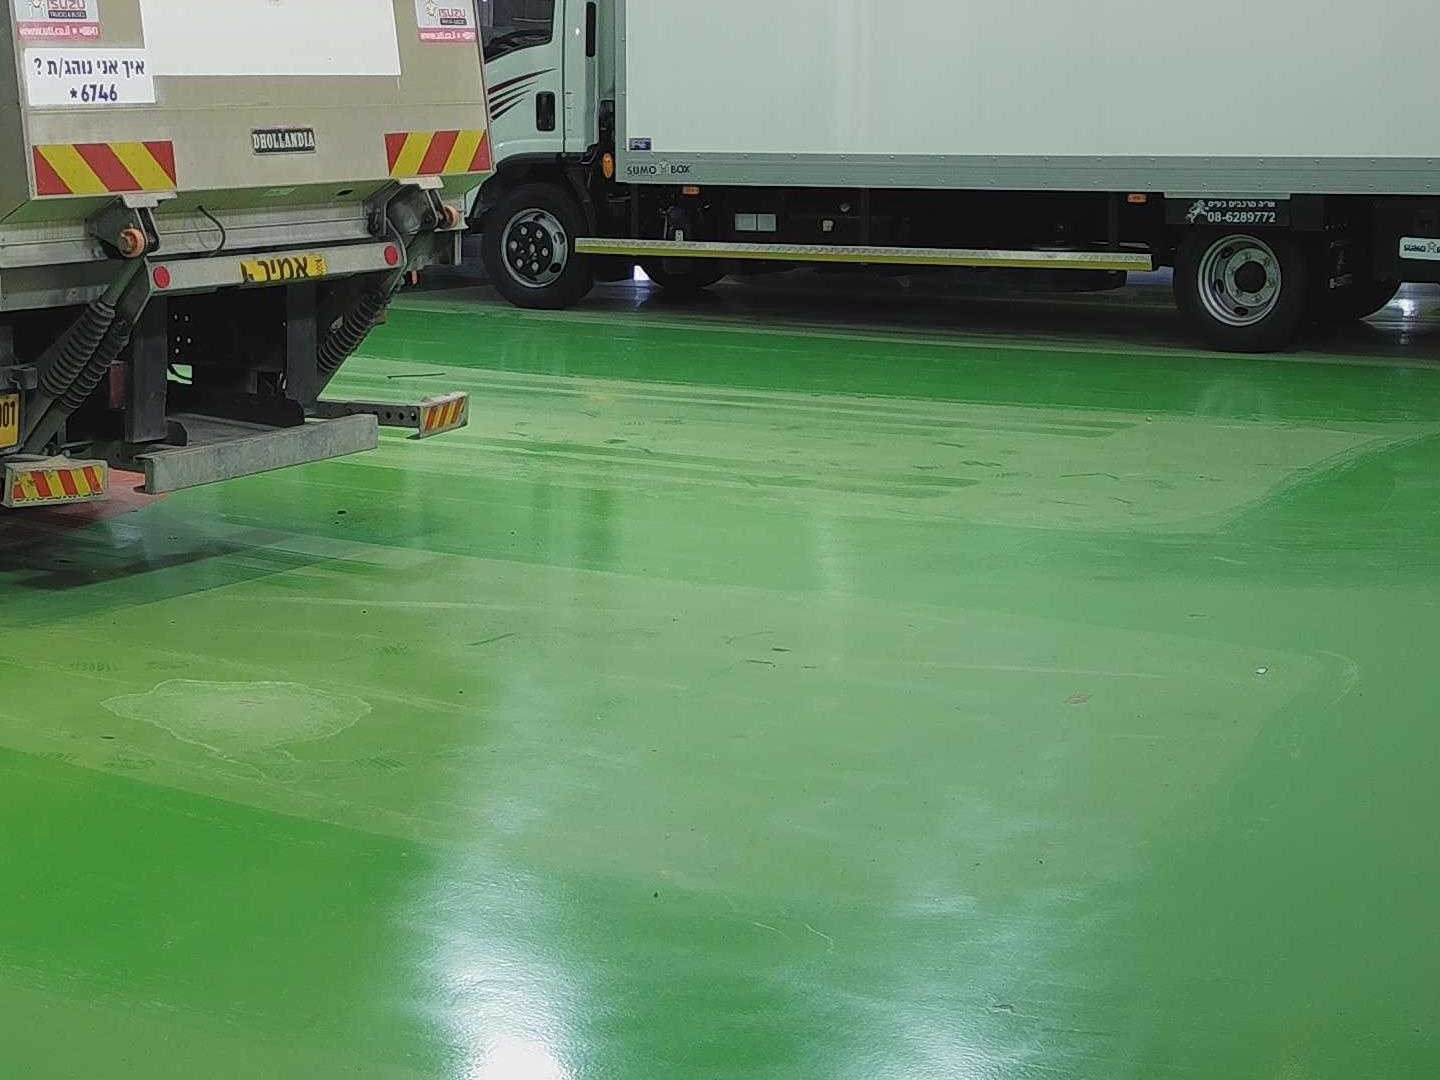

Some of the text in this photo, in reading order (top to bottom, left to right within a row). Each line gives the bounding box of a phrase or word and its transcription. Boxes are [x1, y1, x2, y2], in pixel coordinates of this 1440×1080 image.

[47, 57, 93, 79] נוהג/ת
[97, 59, 120, 76] אני
[121, 59, 145, 79] איך
[252, 131, 316, 149] DHOLLANDIA
[626, 164, 691, 176] SUMO BOX
[1207, 211, 1276, 223] 08-6289772
